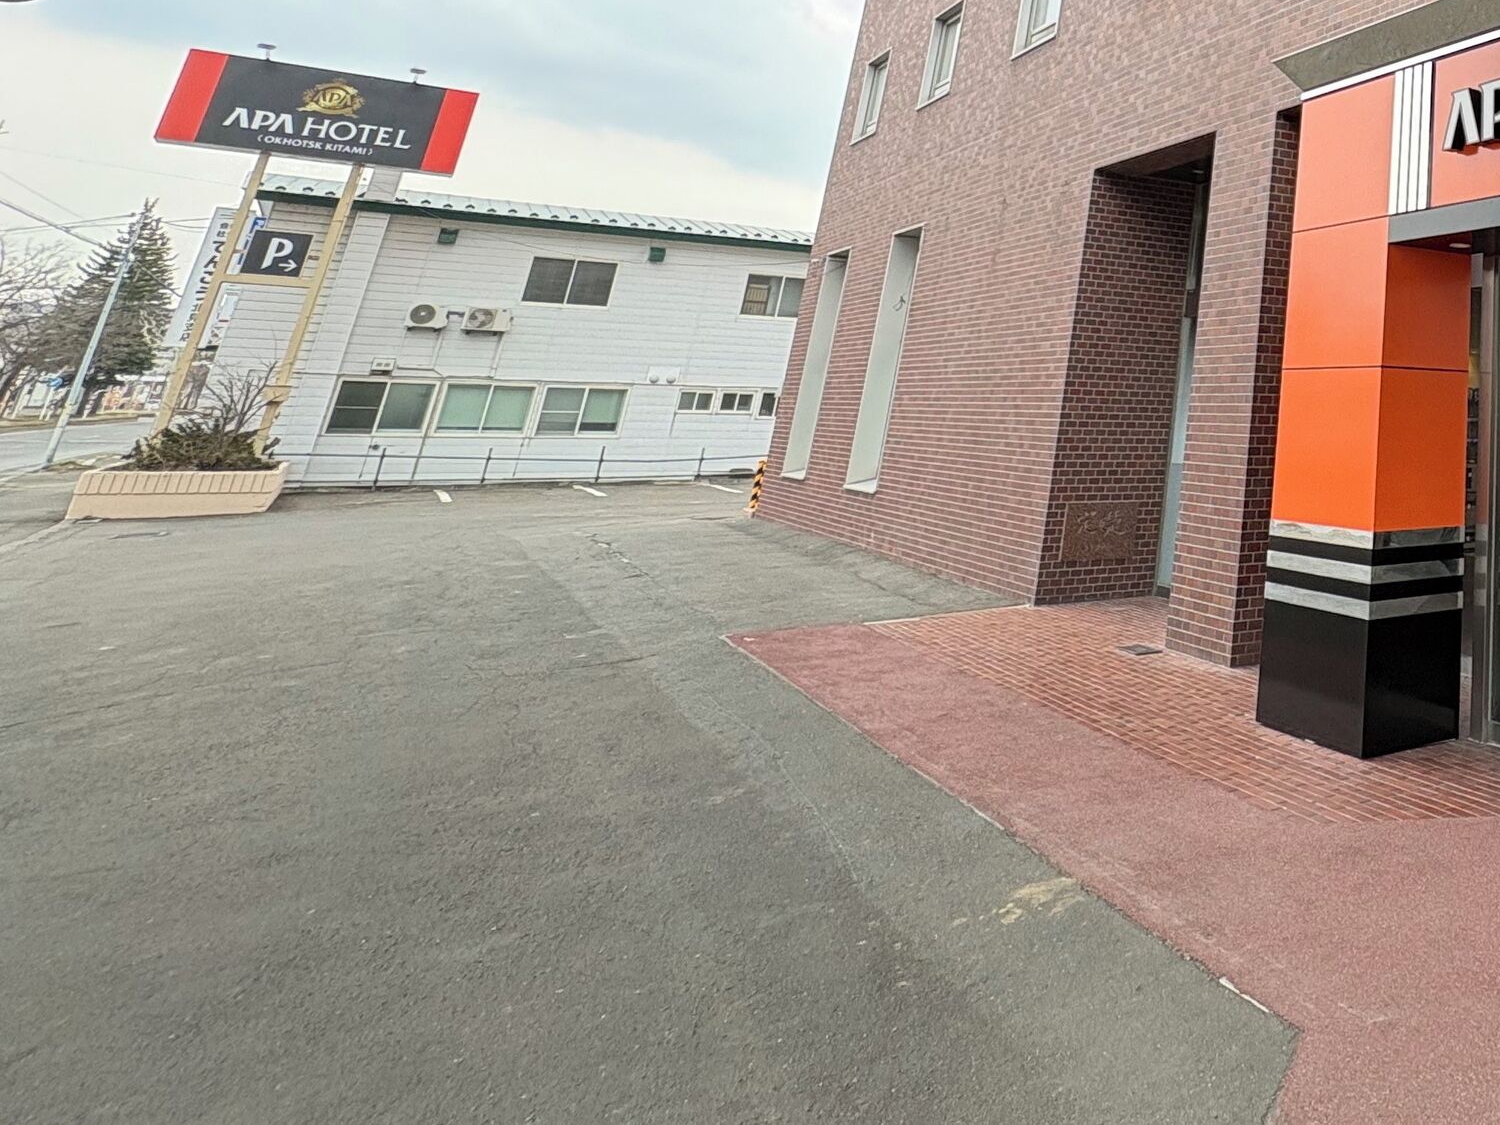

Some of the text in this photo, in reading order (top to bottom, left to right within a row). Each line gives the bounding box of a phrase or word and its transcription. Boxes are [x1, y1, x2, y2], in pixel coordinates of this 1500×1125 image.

[313, 91, 354, 107] APA
[222, 106, 412, 150] APA HOTEL
[260, 237, 294, 271] P
